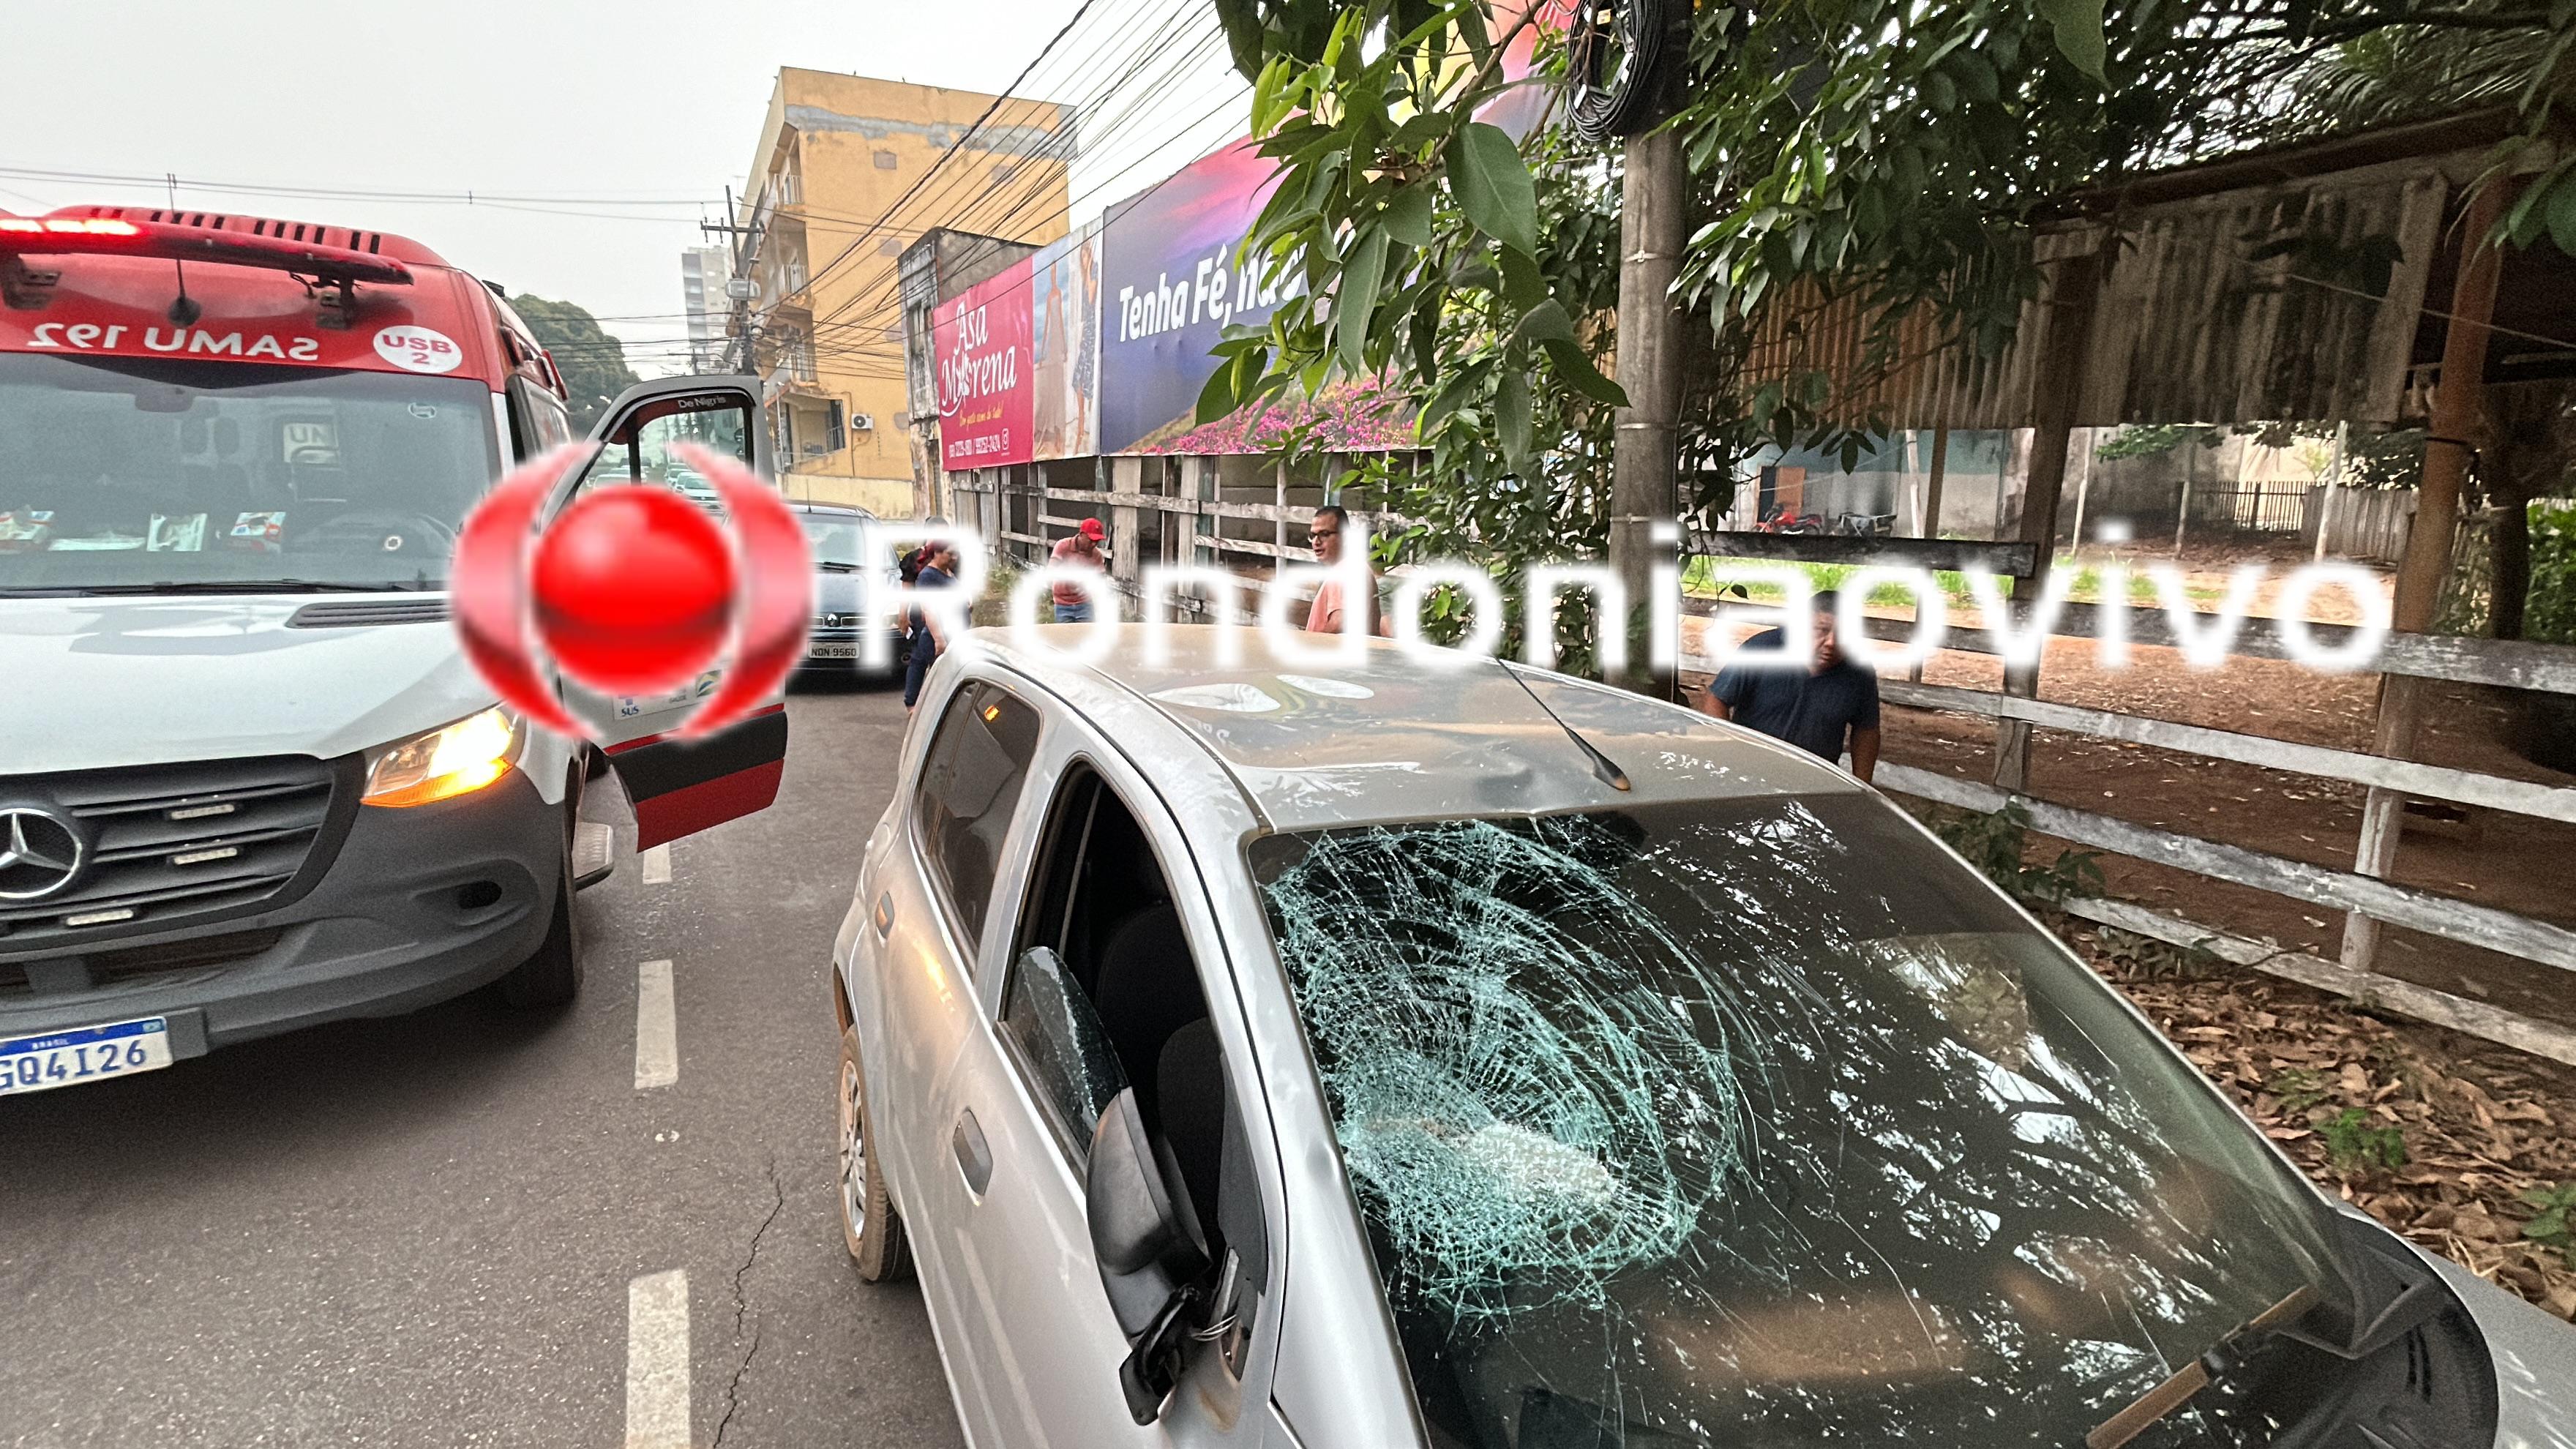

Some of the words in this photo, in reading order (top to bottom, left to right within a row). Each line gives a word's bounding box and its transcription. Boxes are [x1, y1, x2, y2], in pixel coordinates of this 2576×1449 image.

[1120, 272, 1188, 342] Tenha
[1192, 244, 1232, 329] Fé,
[954, 301, 989, 356] Asa
[382, 334, 452, 353] USB
[411, 352, 430, 365] 2
[678, 400, 694, 408] De
[833, 648, 857, 656] 9560
[621, 705, 639, 716] SUS
